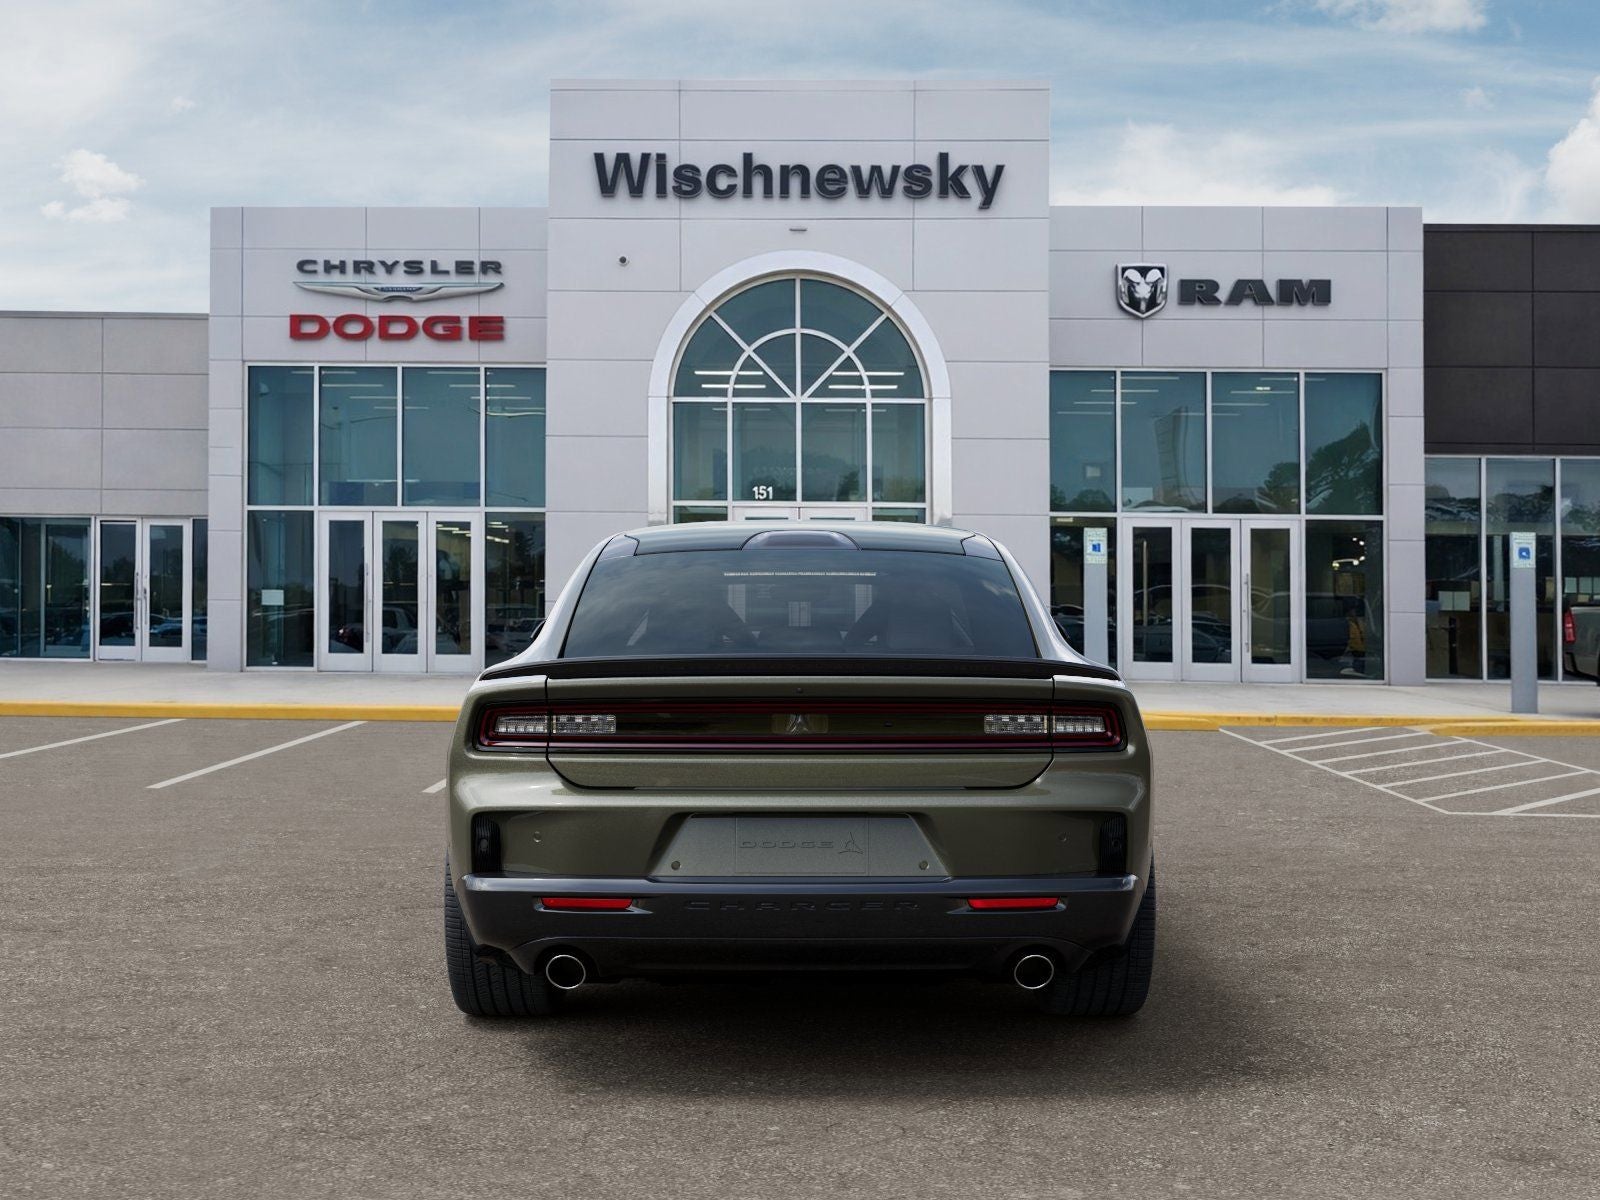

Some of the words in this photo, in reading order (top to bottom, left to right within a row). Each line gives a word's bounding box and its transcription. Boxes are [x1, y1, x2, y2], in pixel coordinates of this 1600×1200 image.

[593, 152, 1006, 210] Wischnewsky
[296, 259, 503, 276] CHRYSLER
[1177, 278, 1332, 306] RAM
[289, 313, 505, 342] DODGE
[751, 485, 773, 500] 151
[738, 839, 835, 850] DODGE
[685, 900, 920, 911] CHARGER
